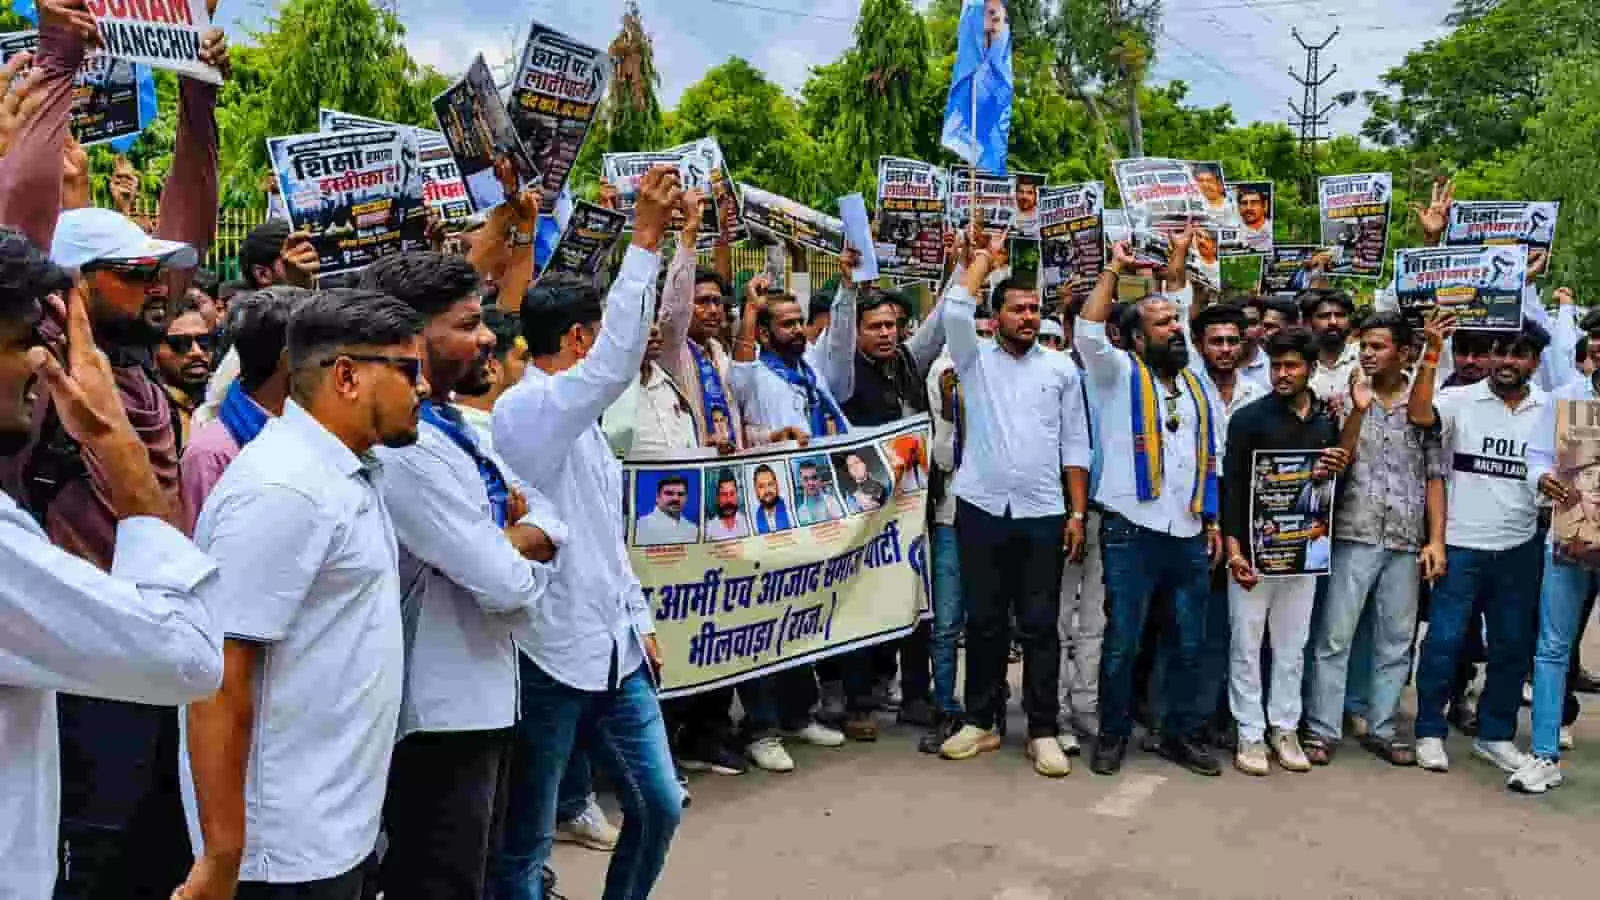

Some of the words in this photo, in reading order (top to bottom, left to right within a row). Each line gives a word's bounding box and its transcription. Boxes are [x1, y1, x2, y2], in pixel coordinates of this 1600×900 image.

[723, 561, 760, 612] एवं
[757, 560, 825, 605] आजाद
[863, 519, 901, 568] पार्टी
[688, 618, 778, 667] भीलवाड़ा
